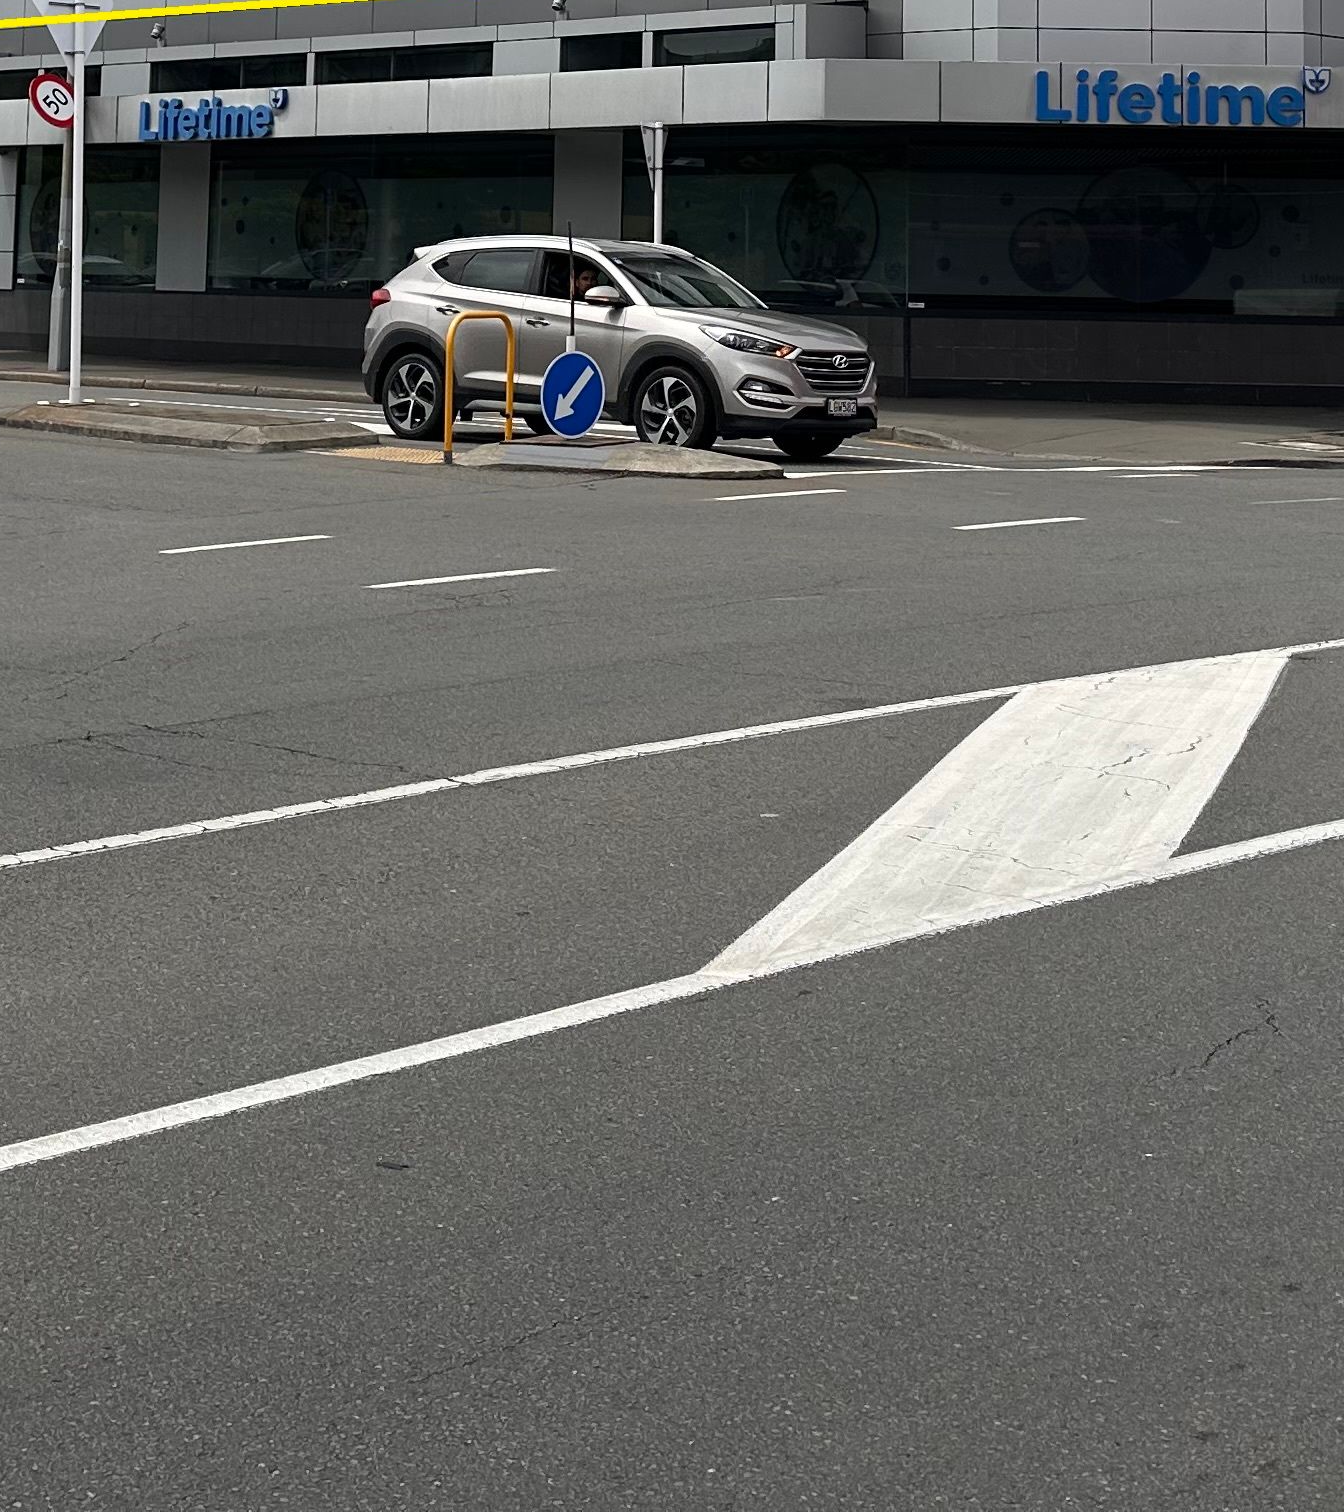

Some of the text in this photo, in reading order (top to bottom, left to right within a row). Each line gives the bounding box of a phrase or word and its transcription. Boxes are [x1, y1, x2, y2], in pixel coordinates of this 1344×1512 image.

[43, 88, 68, 115] 50
[139, 96, 274, 141] Lifetime
[1035, 68, 1304, 126] Lifetime
